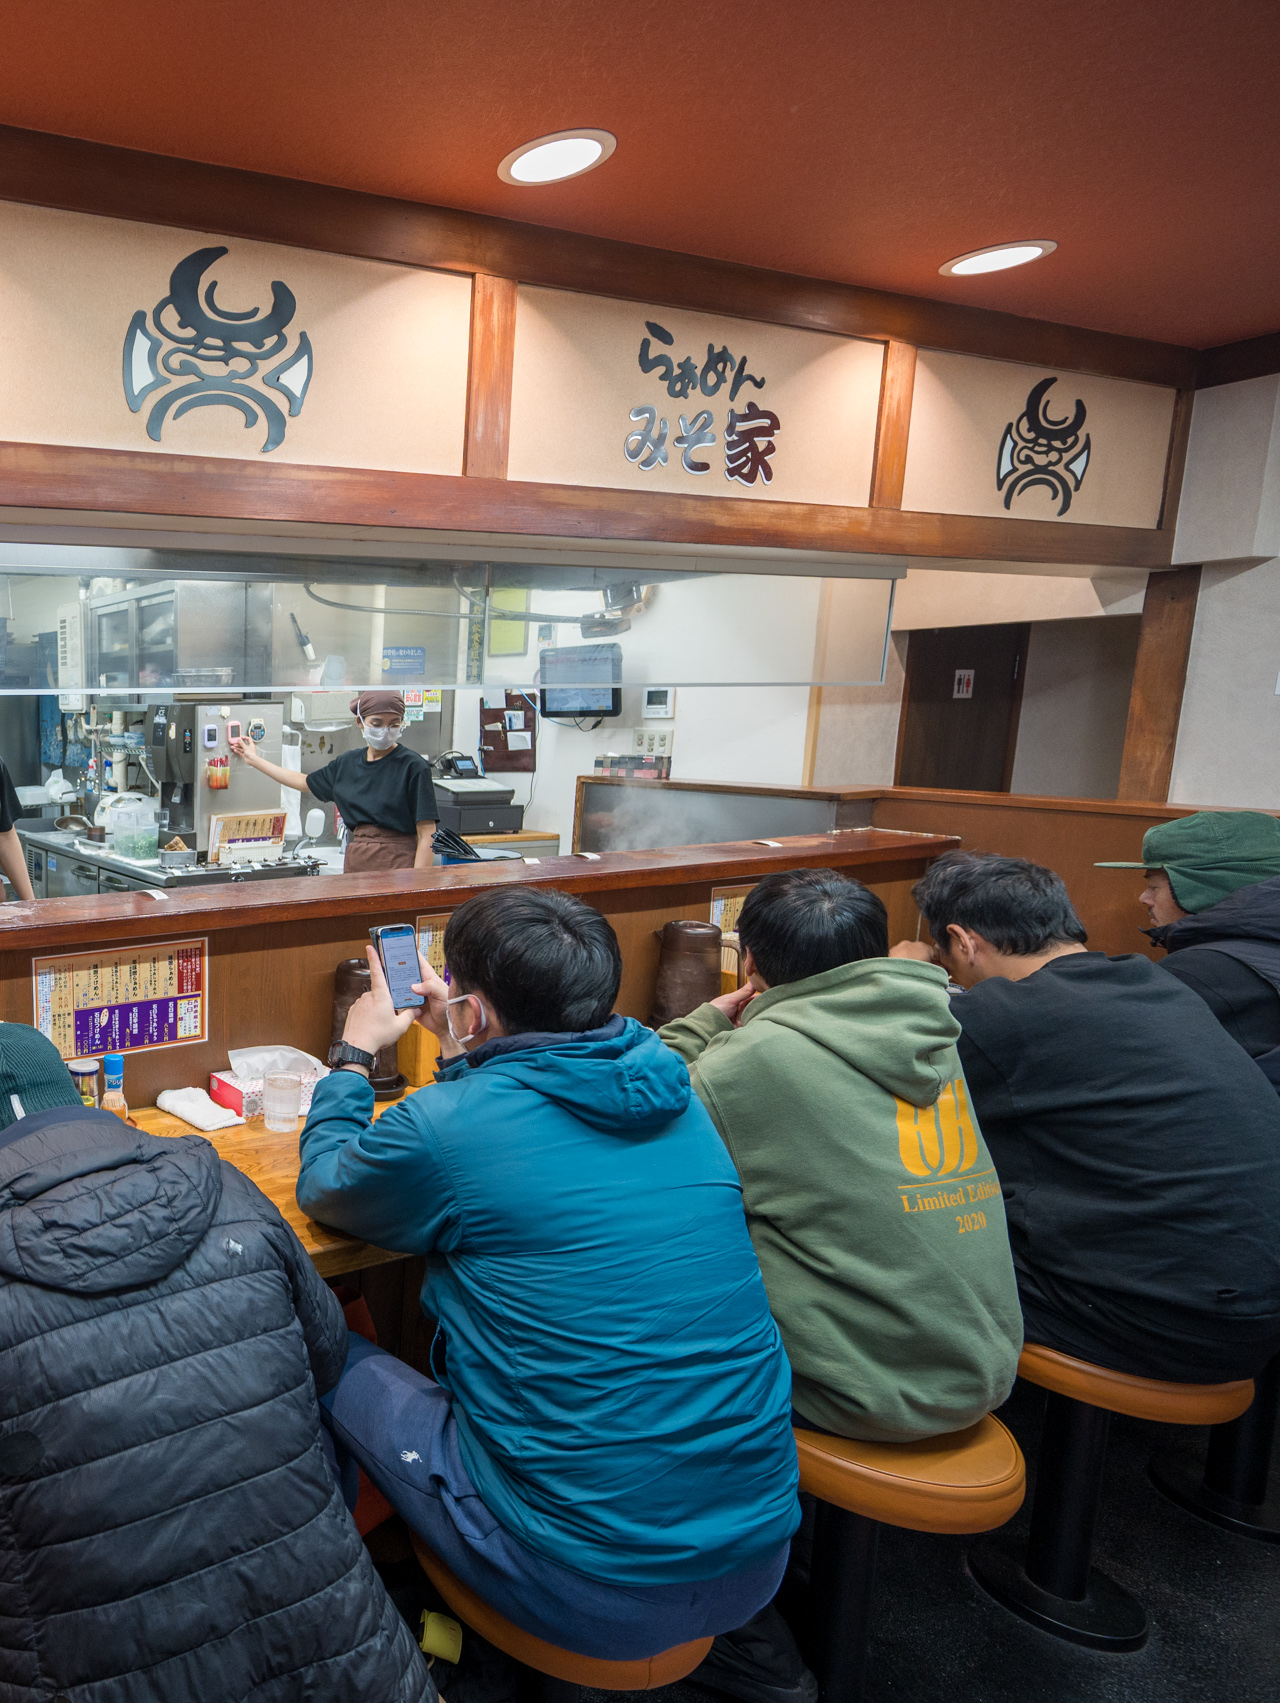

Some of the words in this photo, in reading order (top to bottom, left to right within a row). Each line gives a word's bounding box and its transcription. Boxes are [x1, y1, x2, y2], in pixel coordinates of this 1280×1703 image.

[624, 401, 781, 487] みそ家
[900, 1187, 966, 1212] Limited
[955, 1210, 987, 1234] 2020
